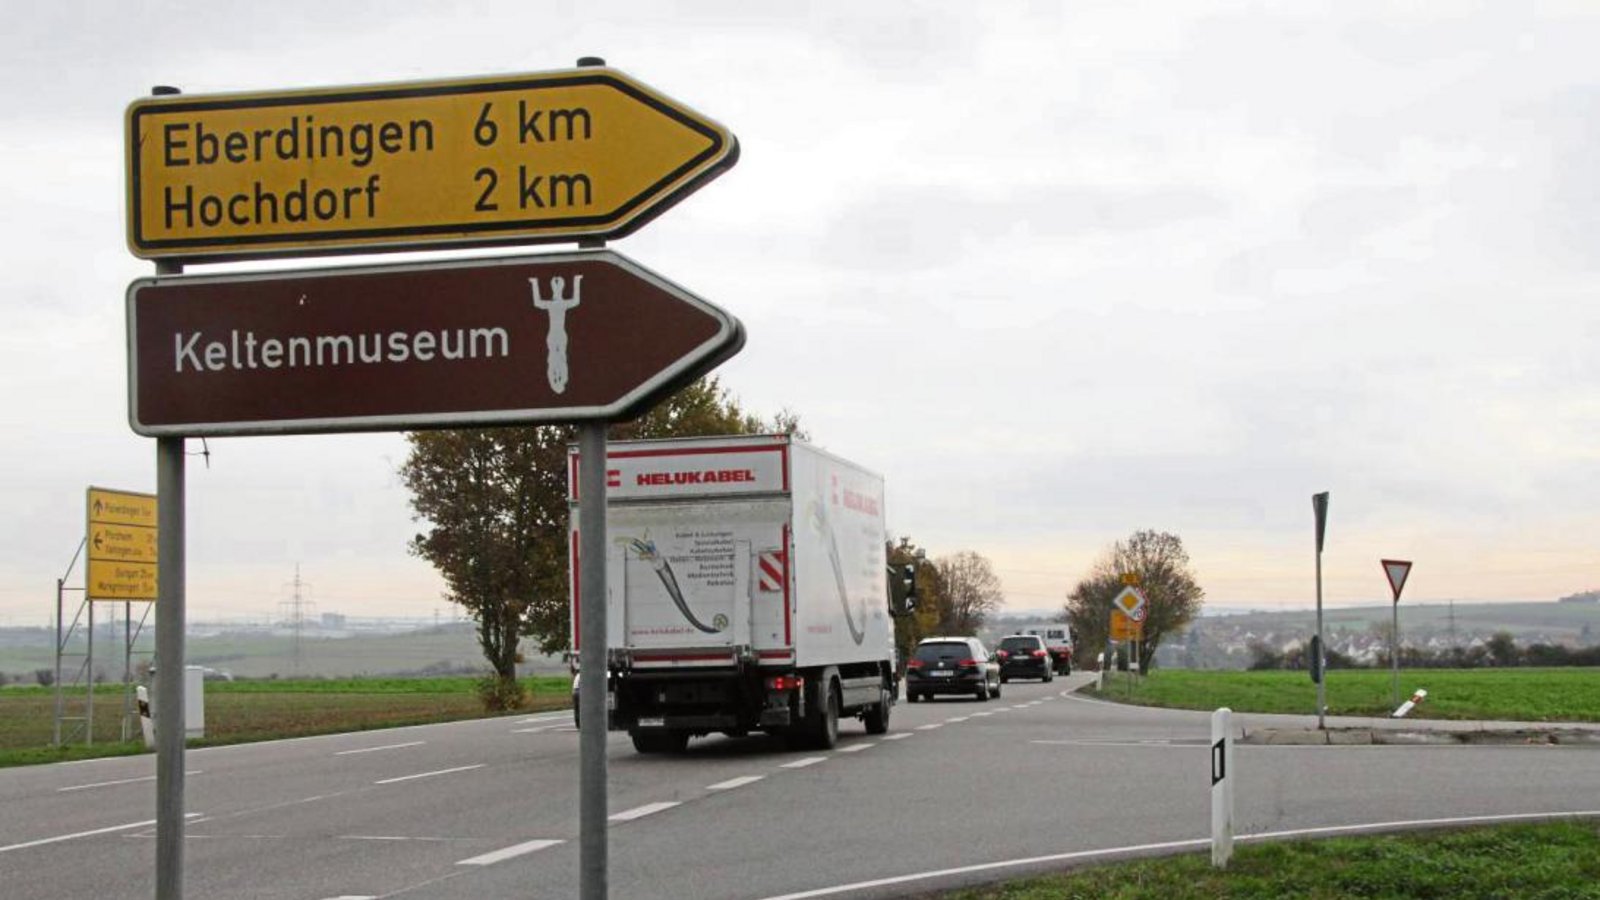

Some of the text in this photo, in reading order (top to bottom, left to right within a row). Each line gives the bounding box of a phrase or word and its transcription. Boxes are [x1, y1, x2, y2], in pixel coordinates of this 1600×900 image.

[163, 100, 592, 167] Eberdingen 6 km
[164, 165, 593, 229] Hochdorf 2 km
[174, 325, 510, 373] Keltenmuseum
[637, 469, 756, 486] HELUKABEL
